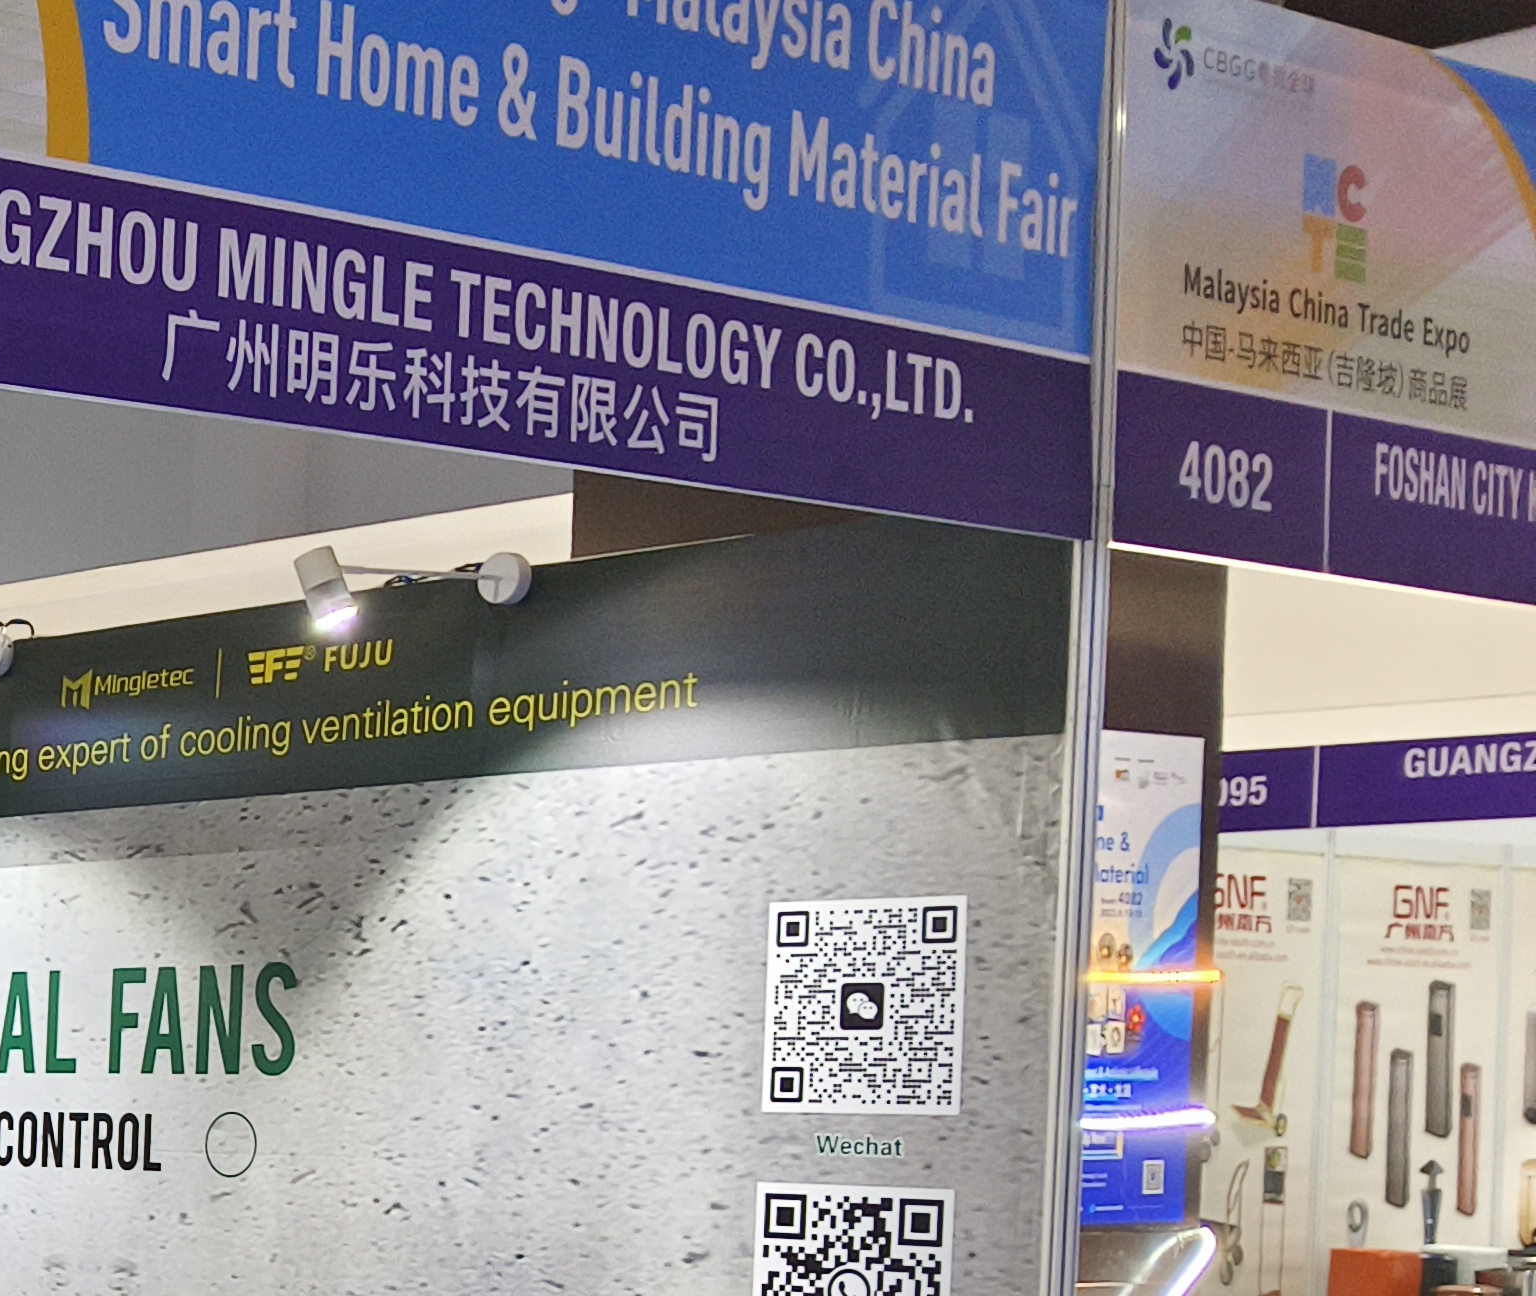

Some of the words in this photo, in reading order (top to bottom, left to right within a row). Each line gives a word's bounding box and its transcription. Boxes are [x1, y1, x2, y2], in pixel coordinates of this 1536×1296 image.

[628, 0, 853, 70] aysia
[868, 0, 996, 107] China
[103, 0, 297, 89] Smart
[317, 2, 480, 128] Home
[498, 43, 537, 141] &
[556, 55, 772, 211] Building
[789, 109, 984, 238] Material
[998, 160, 1078, 257] Fair
[218, 228, 434, 333] MINGLE
[451, 267, 782, 390] TECHNOLOGY
[795, 332, 975, 424] CO.,LTD.
[1183, 263, 1280, 315] Malaysia
[1289, 287, 1349, 330] China
[1359, 302, 1415, 344] Trade
[1423, 317, 1470, 359] Expo
[162, 309, 721, 462] 广州明乐科技有限公司
[1179, 440, 1274, 513] 4082
[1374, 441, 1468, 513] FOSHAN
[1473, 457, 1523, 522] CITY
[94, 667, 195, 699] Mingletec
[324, 639, 394, 673] FUJU
[38, 732, 131, 775] expert
[141, 723, 172, 761] of
[180, 715, 292, 757] cooling
[302, 694, 475, 745] ventilation
[486, 672, 700, 737] equipment
[108, 961, 299, 1077] FANS
[816, 1134, 905, 1159] Wechat
